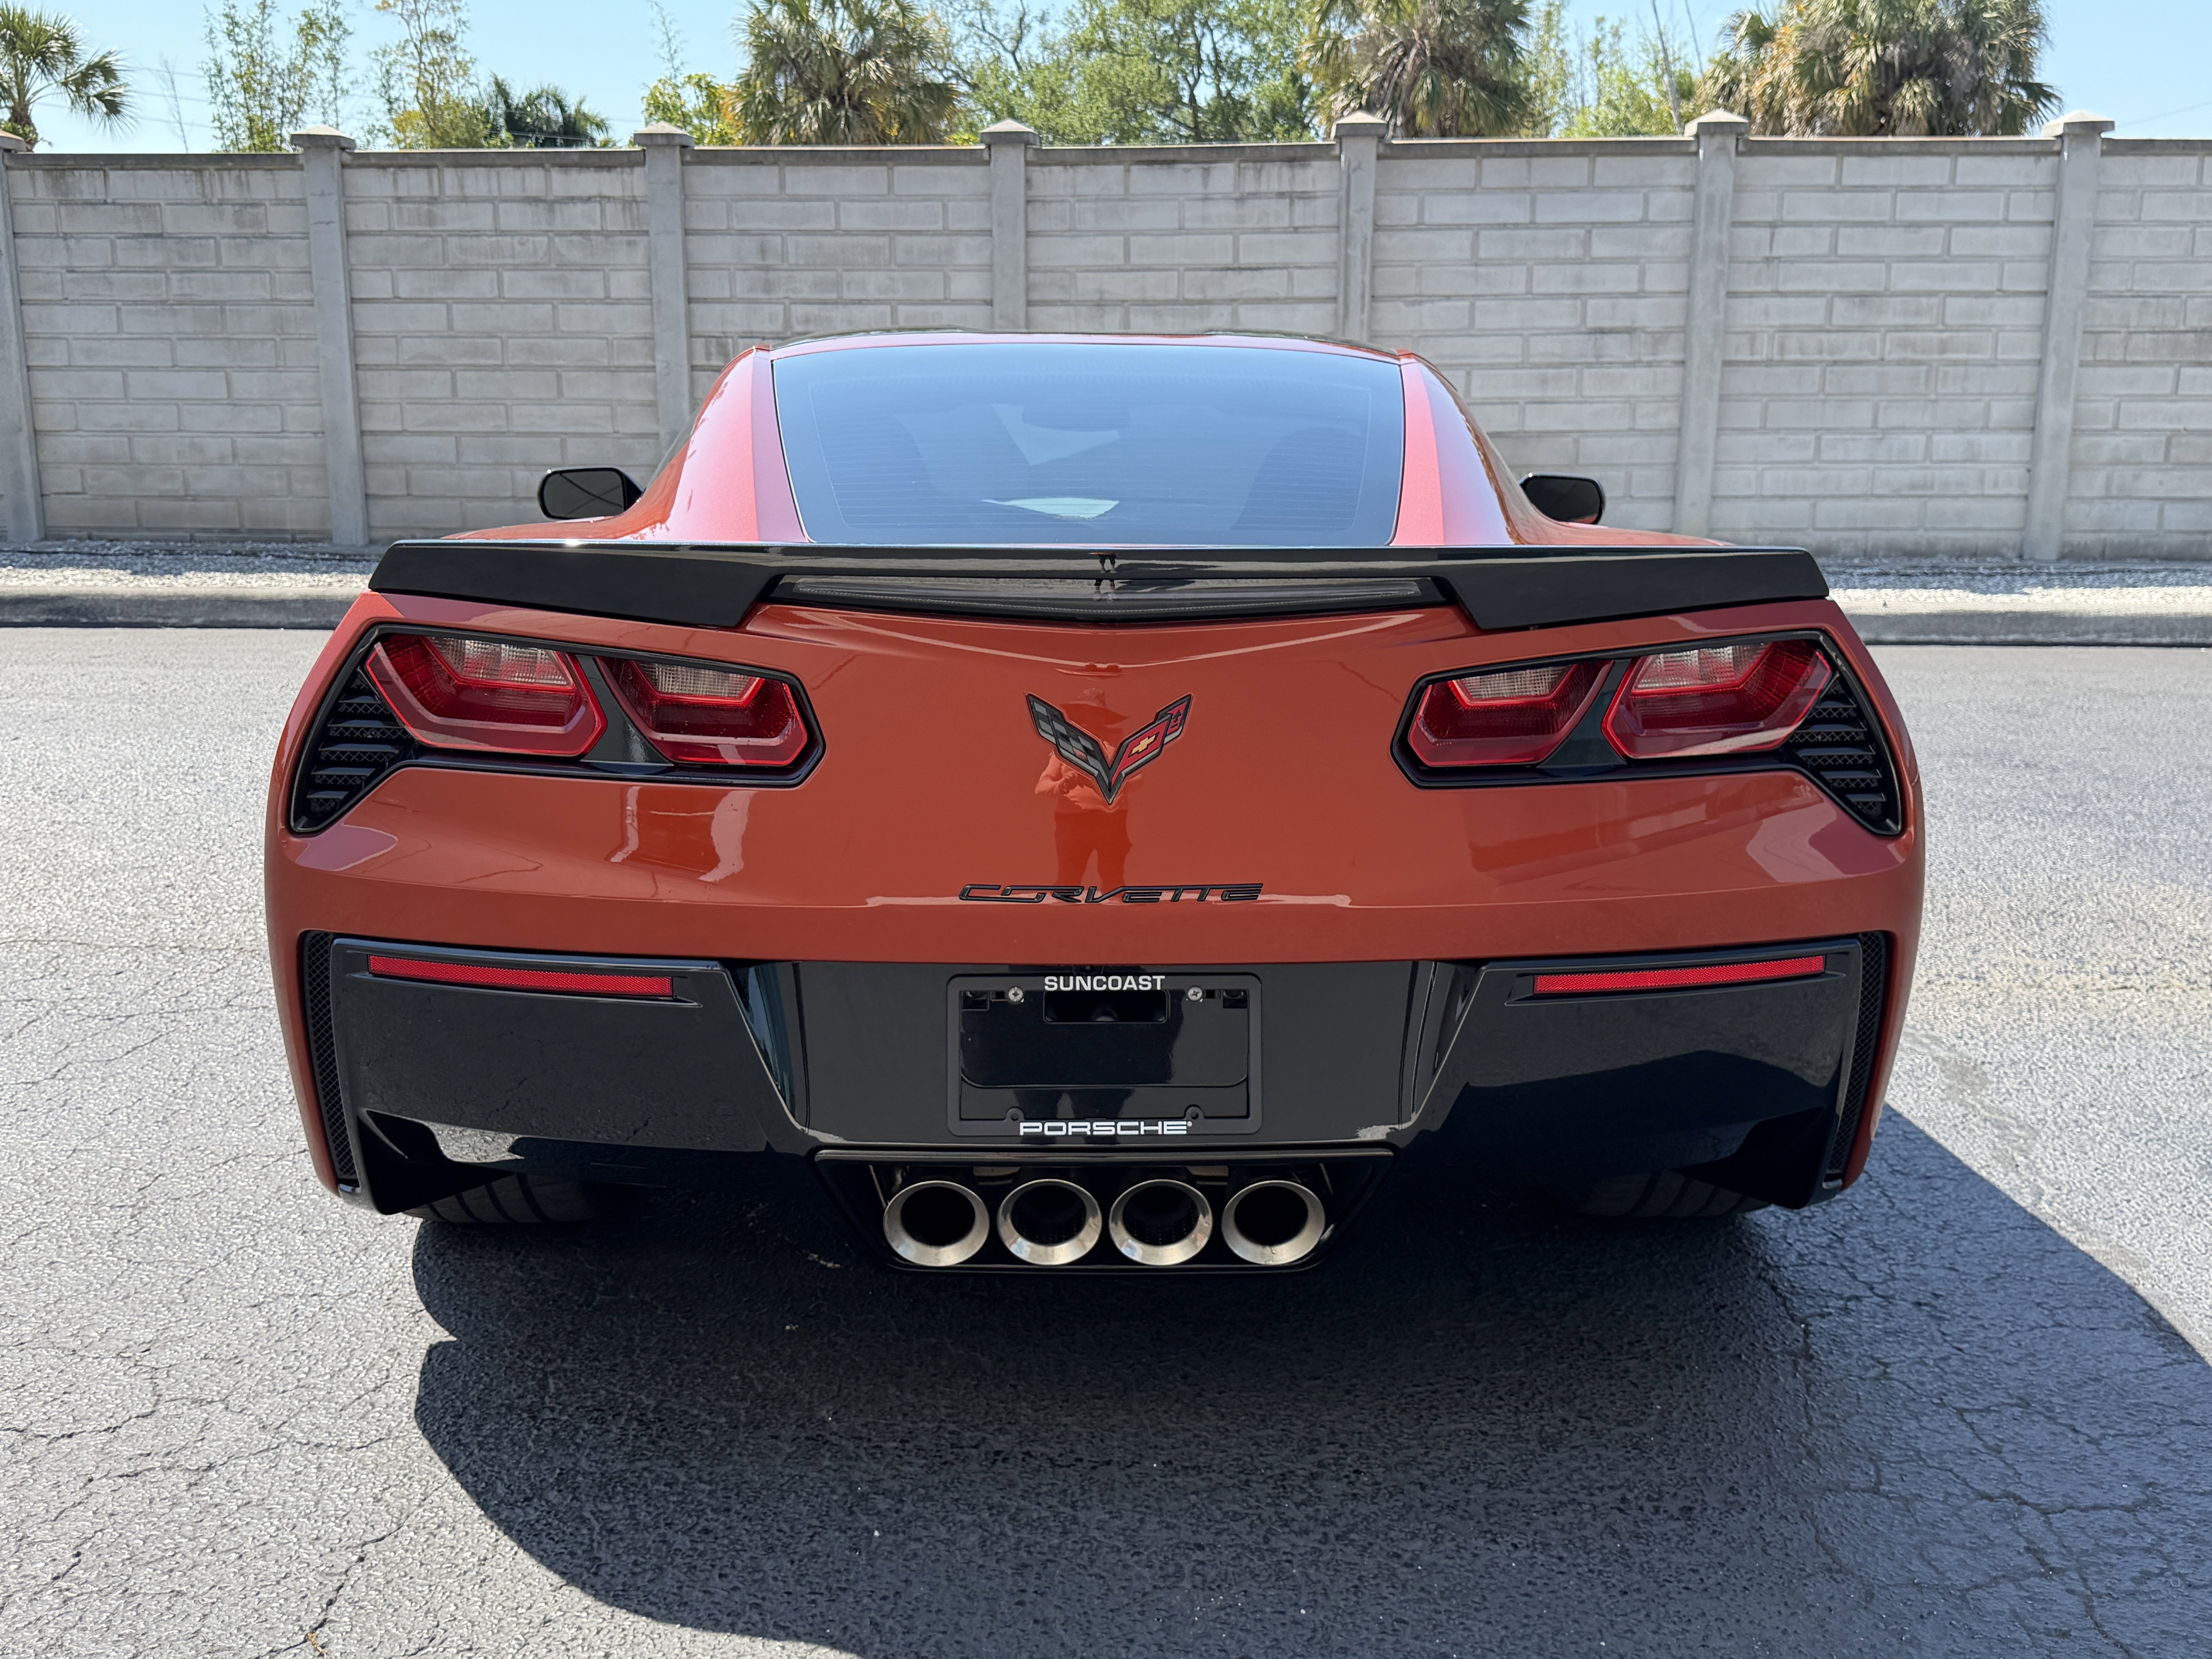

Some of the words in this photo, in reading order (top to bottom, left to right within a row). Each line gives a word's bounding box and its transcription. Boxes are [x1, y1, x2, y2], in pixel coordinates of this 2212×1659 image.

[958, 883, 1263, 903] CORVETTE
[1044, 975, 1165, 991] SUNCOAST
[1020, 1121, 1187, 1135] PORSCHE
